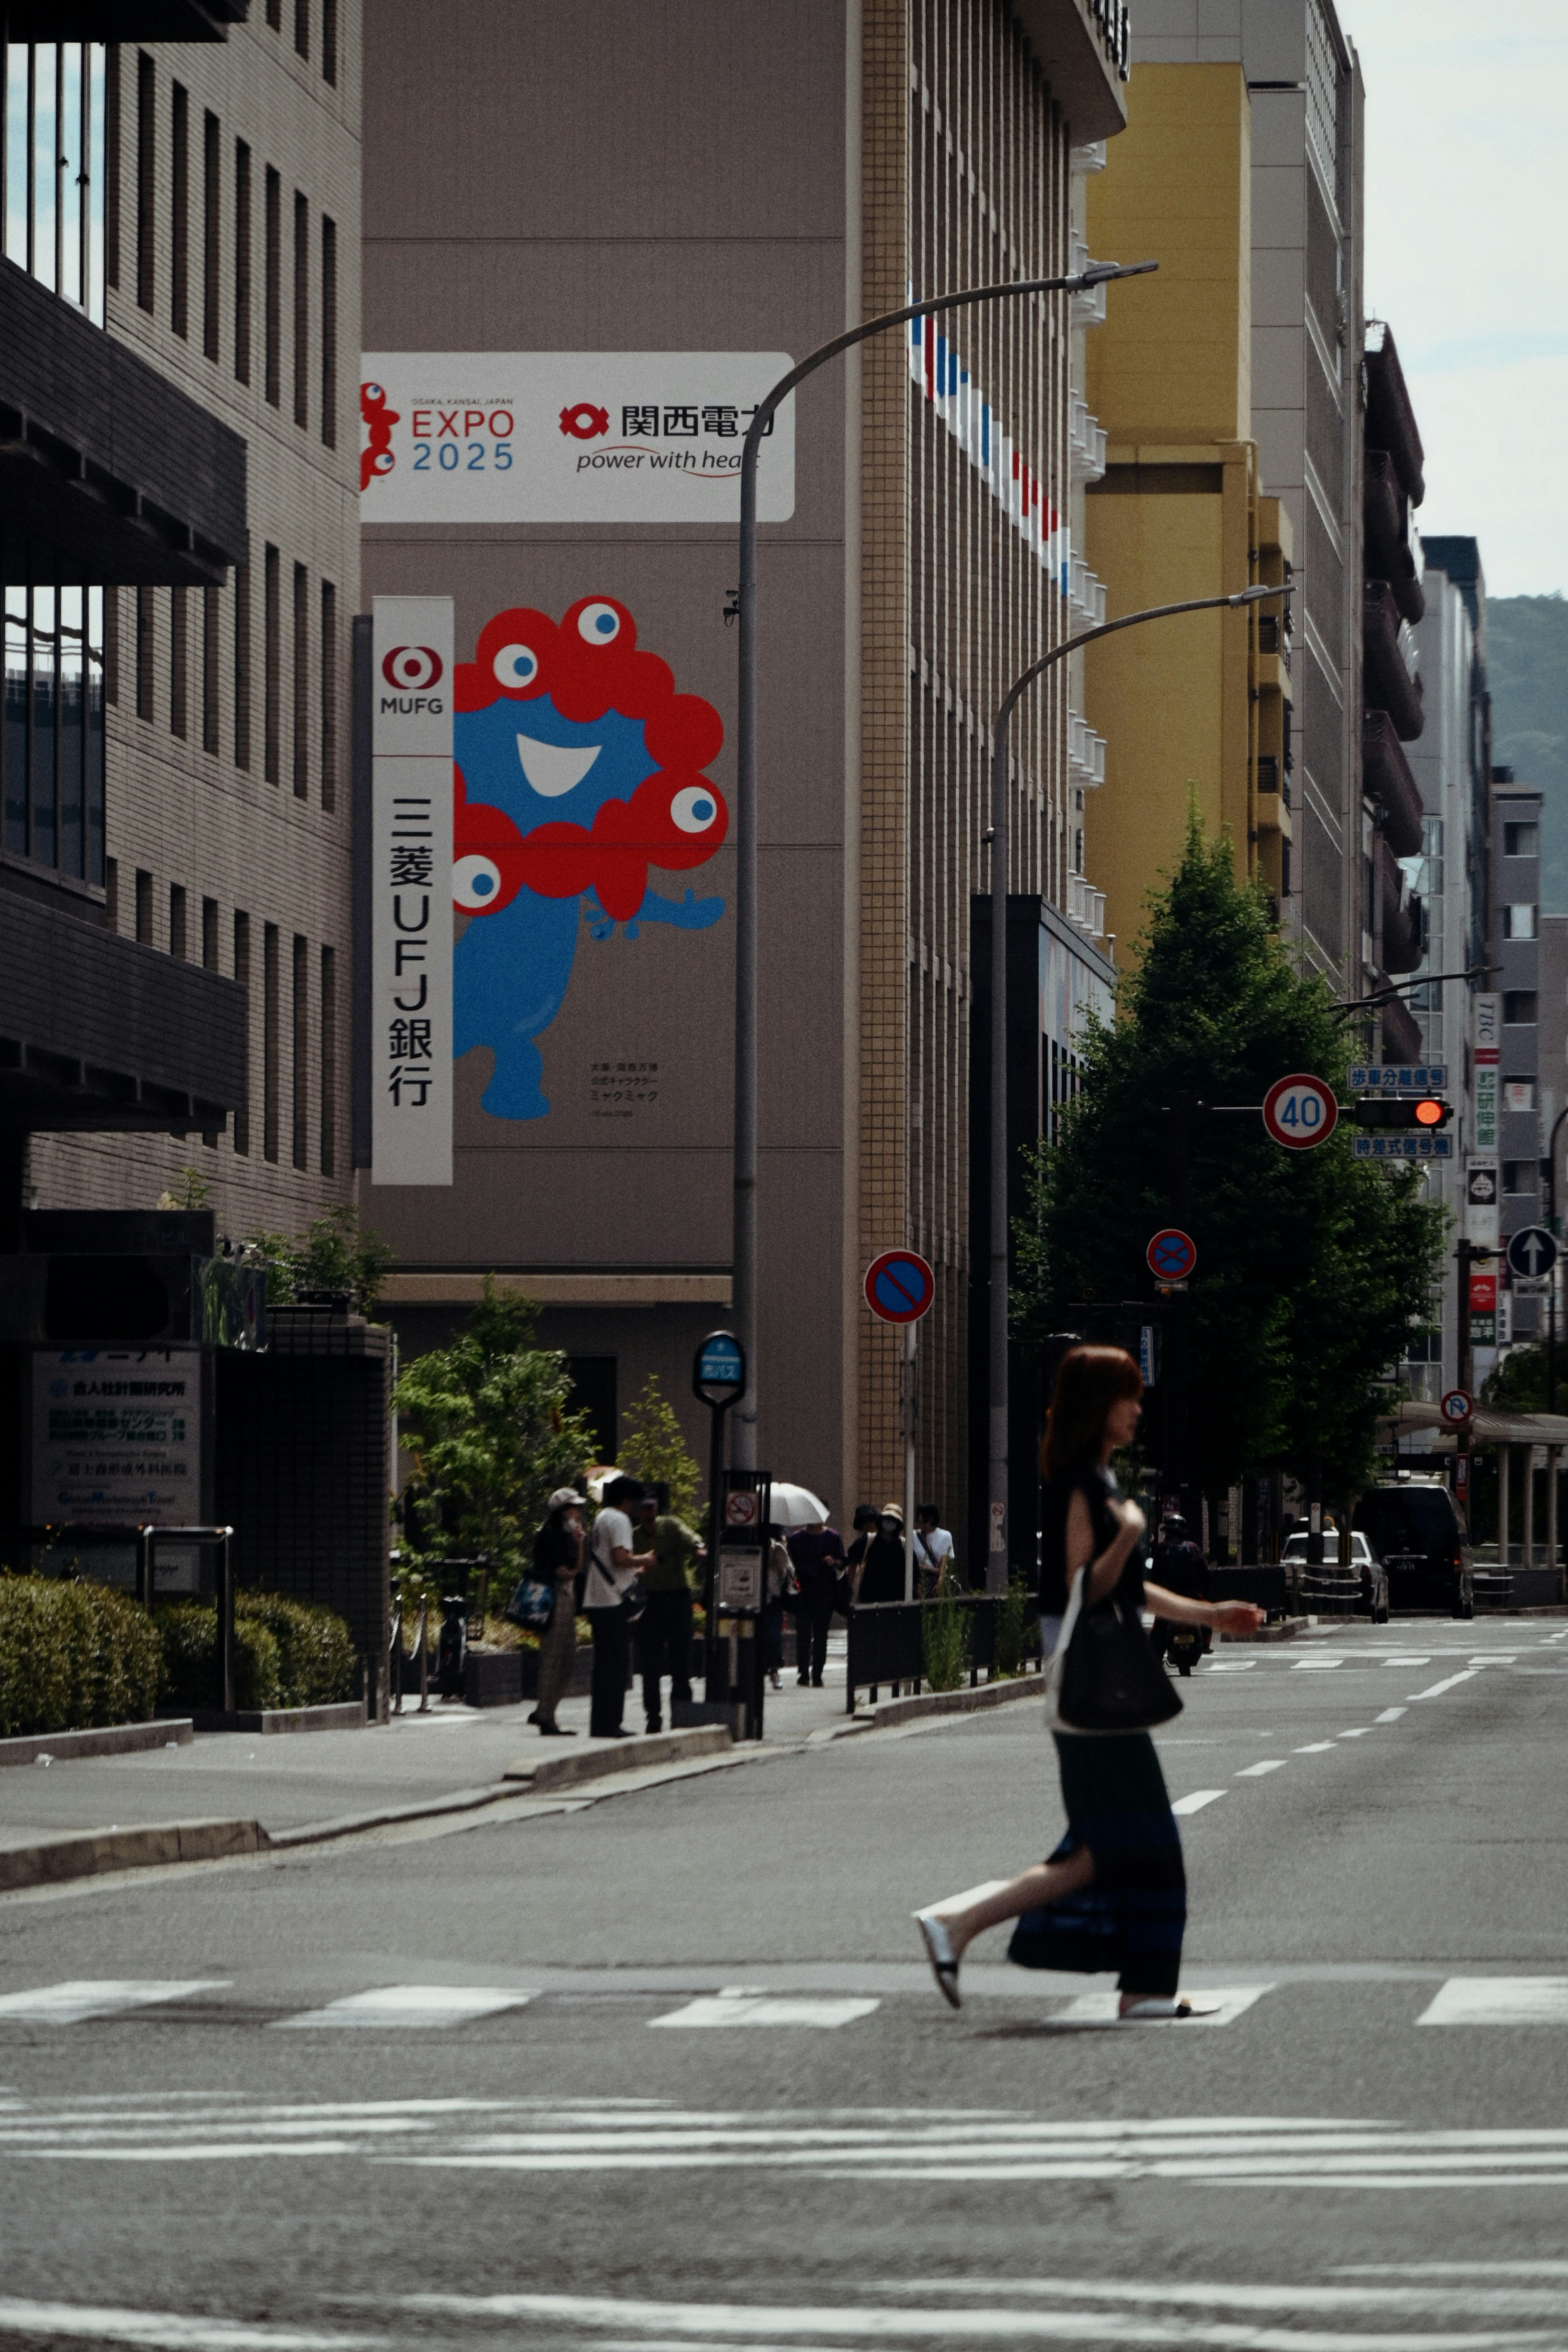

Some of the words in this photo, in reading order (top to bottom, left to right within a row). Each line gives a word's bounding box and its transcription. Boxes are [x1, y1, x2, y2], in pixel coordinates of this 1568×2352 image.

[413, 410, 514, 438] EXPO
[413, 443, 513, 470] 2025
[577, 455, 645, 473] power
[651, 451, 696, 468] with
[702, 451, 761, 468] hea
[380, 698, 443, 715] MUFG
[389, 798, 433, 1107] 三菱UFJ銀行
[1353, 1069, 1444, 1085] 歩車分離信号
[1282, 1096, 1320, 1127] 40
[1357, 1139, 1449, 1156] 時差式信号機
